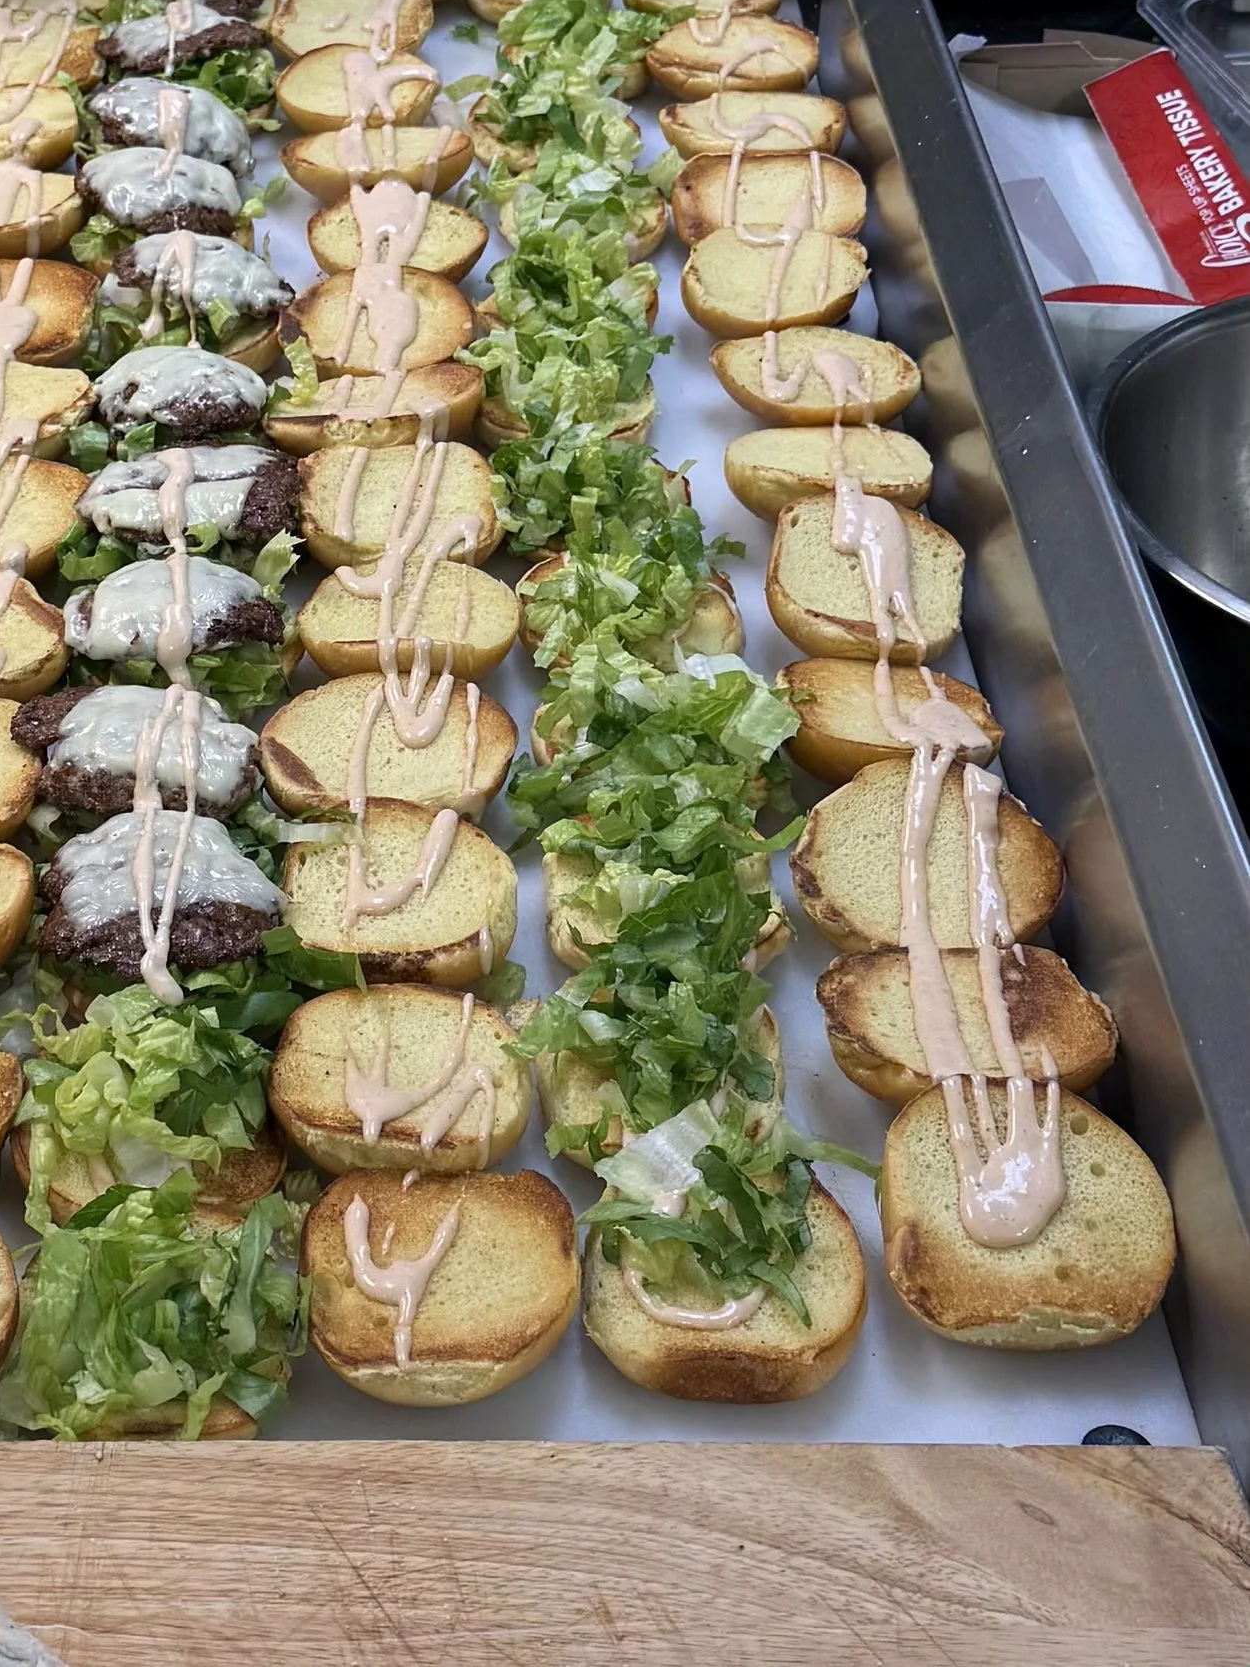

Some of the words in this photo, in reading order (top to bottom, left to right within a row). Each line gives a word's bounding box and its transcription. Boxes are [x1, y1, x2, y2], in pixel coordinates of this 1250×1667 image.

[1155, 89, 1206, 148] TISSUE
[1175, 164, 1201, 197] SHEETS
[1185, 145, 1245, 216] BAKERY
[1192, 196, 1208, 210] UP
[1199, 209, 1217, 226] POP
